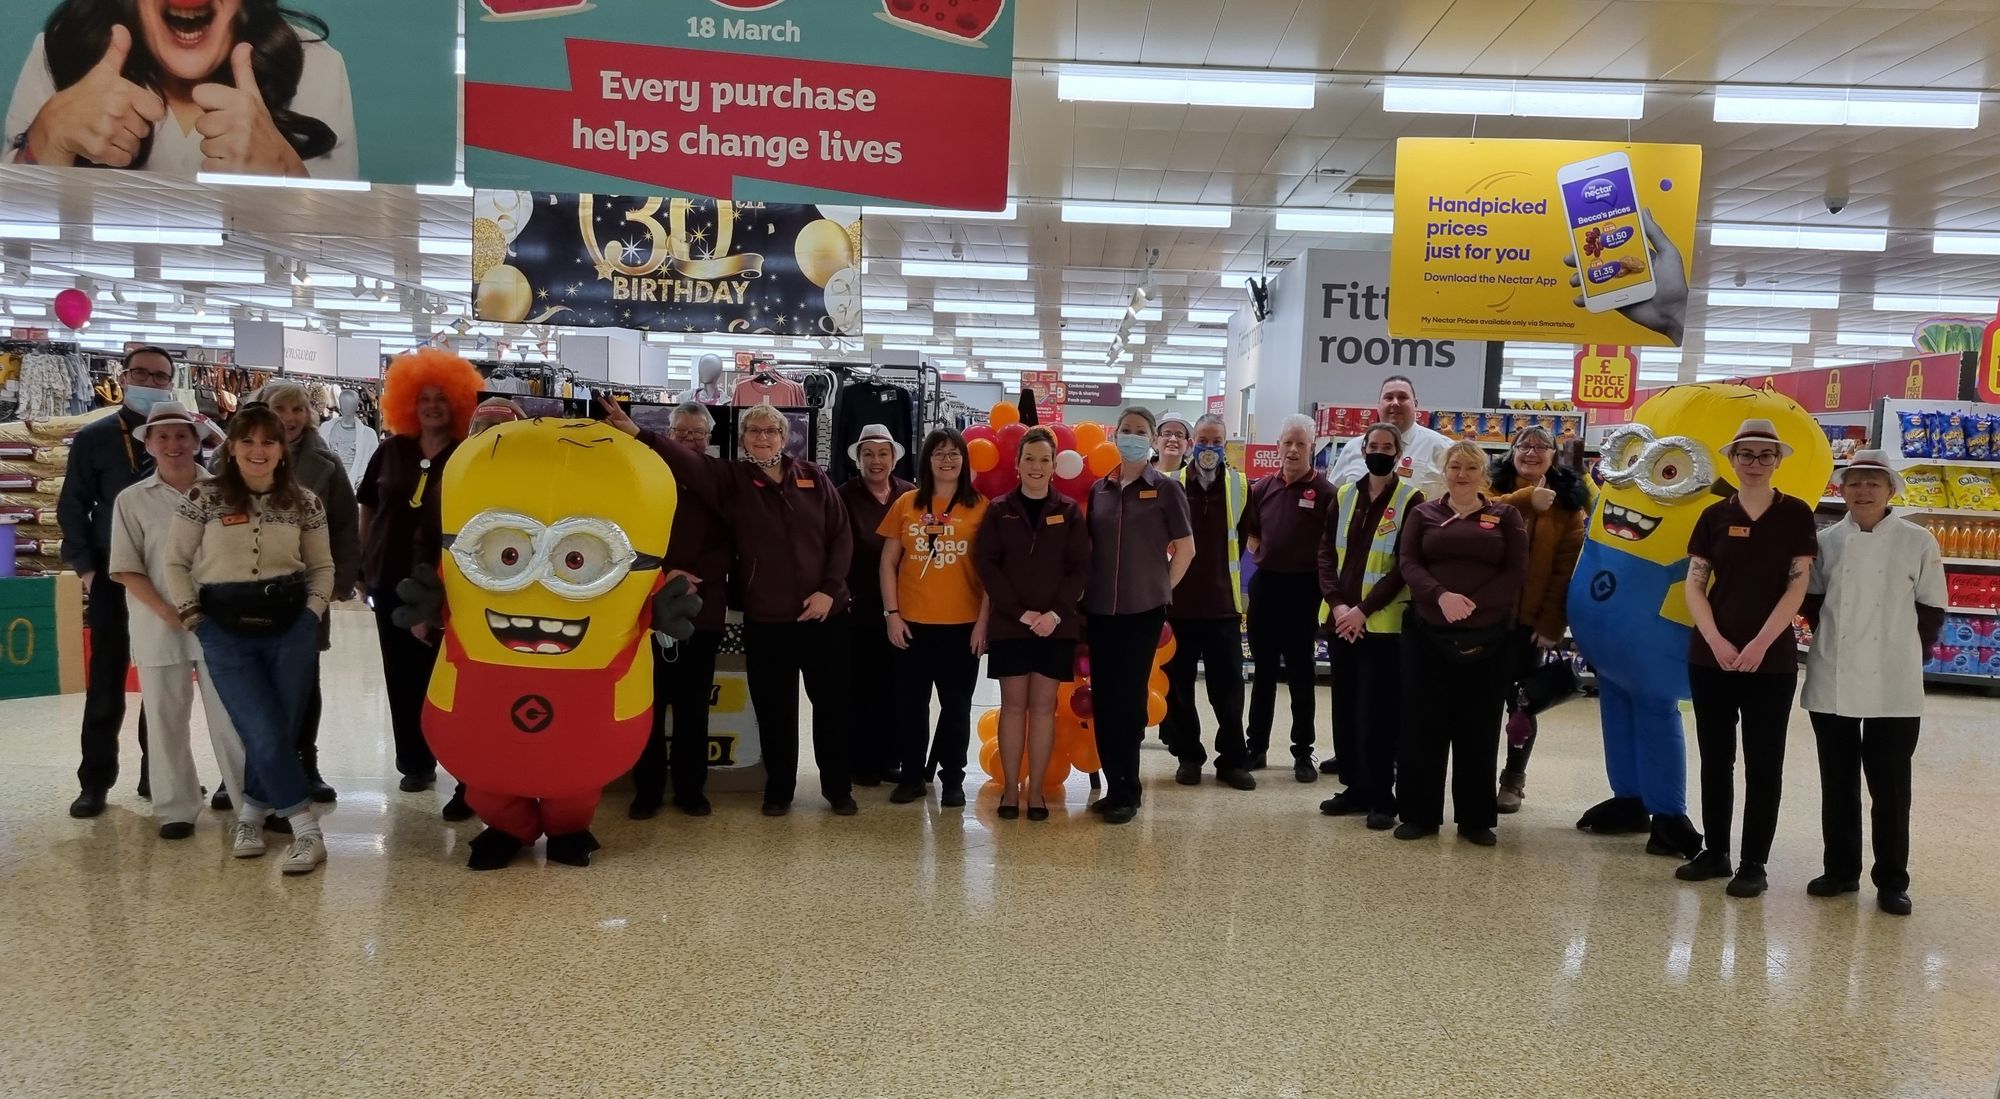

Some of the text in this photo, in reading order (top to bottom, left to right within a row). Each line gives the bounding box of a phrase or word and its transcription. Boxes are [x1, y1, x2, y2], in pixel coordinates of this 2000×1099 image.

[687, 17, 801, 42] 18 March
[600, 70, 876, 113] Every purchase
[572, 118, 903, 167] helps change lives
[1584, 185, 1613, 199] nectar
[1428, 196, 1547, 217] Handpicked
[1578, 206, 1631, 225] Becca's prices
[1427, 219, 1488, 238] prices
[1606, 230, 1628, 243] £1.50
[1424, 242, 1530, 264] just for you
[1424, 272, 1557, 287] Download the Nectar App
[1593, 265, 1614, 278] £1.35
[613, 276, 750, 304] BIRTHDAY
[1421, 316, 1575, 328] My Nectar Prices available only via Smartshop
[285, 347, 318, 361] enswear
[1319, 335, 1456, 368] rooms
[1600, 359, 1611, 374] £
[1584, 375, 1624, 386] PRICE
[1583, 385, 1625, 399] LOCK
[908, 523, 955, 537] Scn
[934, 538, 968, 556] bag
[934, 553, 957, 569] go
[0, 617, 34, 666] 0
